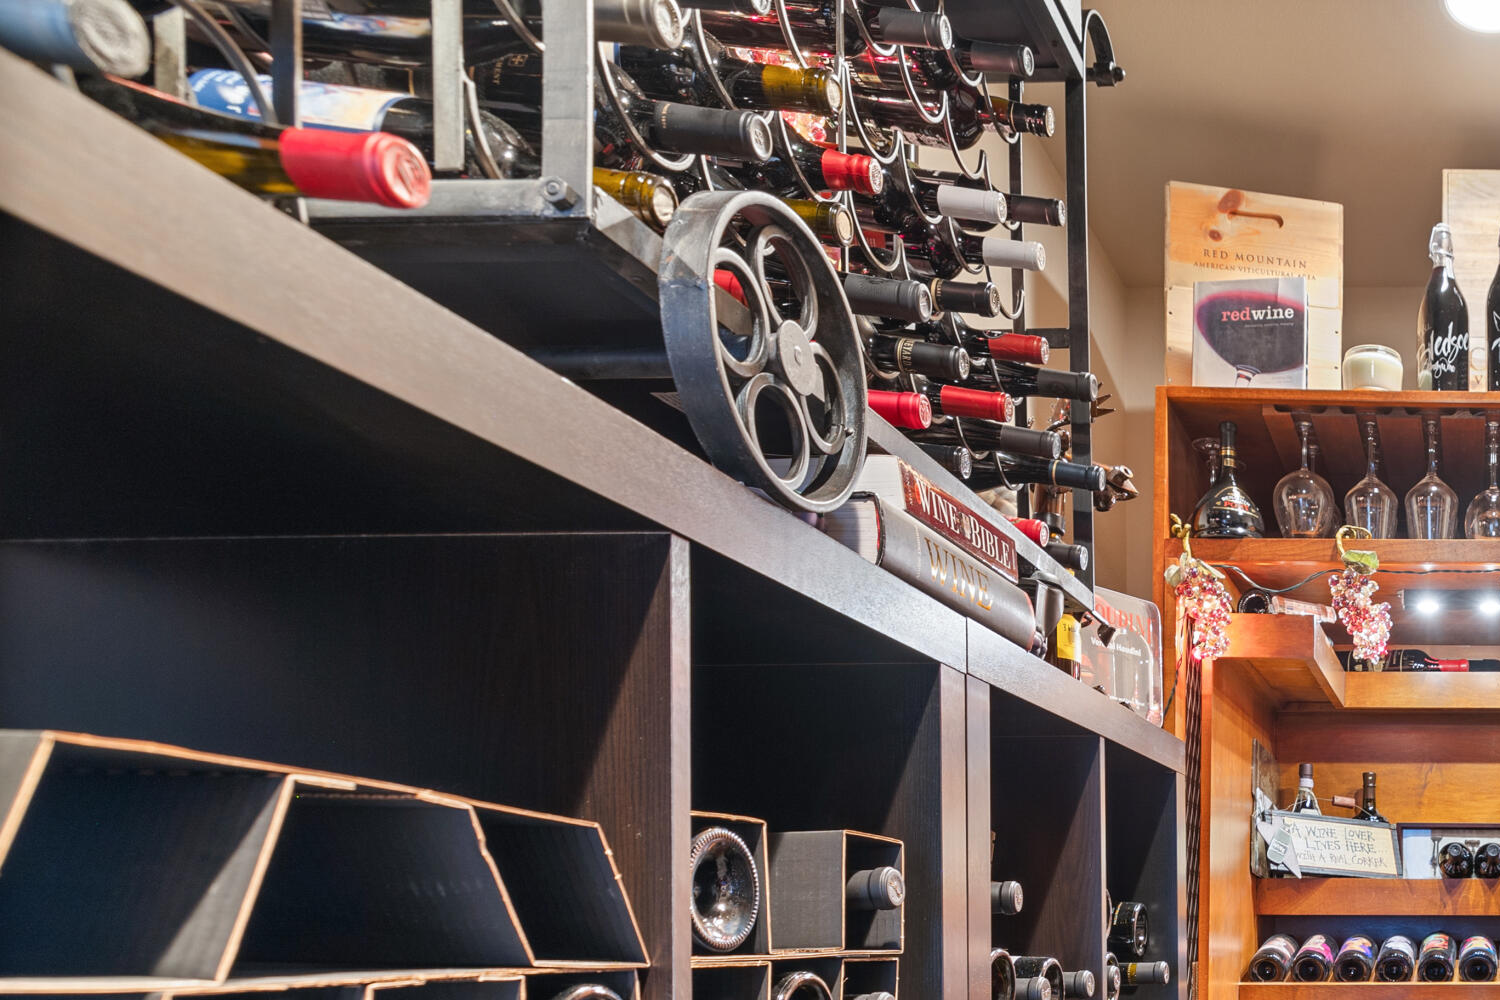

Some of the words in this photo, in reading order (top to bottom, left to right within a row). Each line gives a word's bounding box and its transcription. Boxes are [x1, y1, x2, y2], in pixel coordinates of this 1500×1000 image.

[1193, 261, 1236, 273] AMERICAN
[1203, 249, 1229, 260] RED
[1235, 253, 1307, 269] MOUNTAIN
[915, 476, 960, 535] WINE
[968, 514, 1011, 570] BIBLE
[924, 536, 993, 612] WINE
[1094, 602, 1152, 645] OUDINI
[1305, 825, 1337, 840] WINE
[1344, 827, 1376, 842] LOVER
[1305, 838, 1340, 852] LIVES
